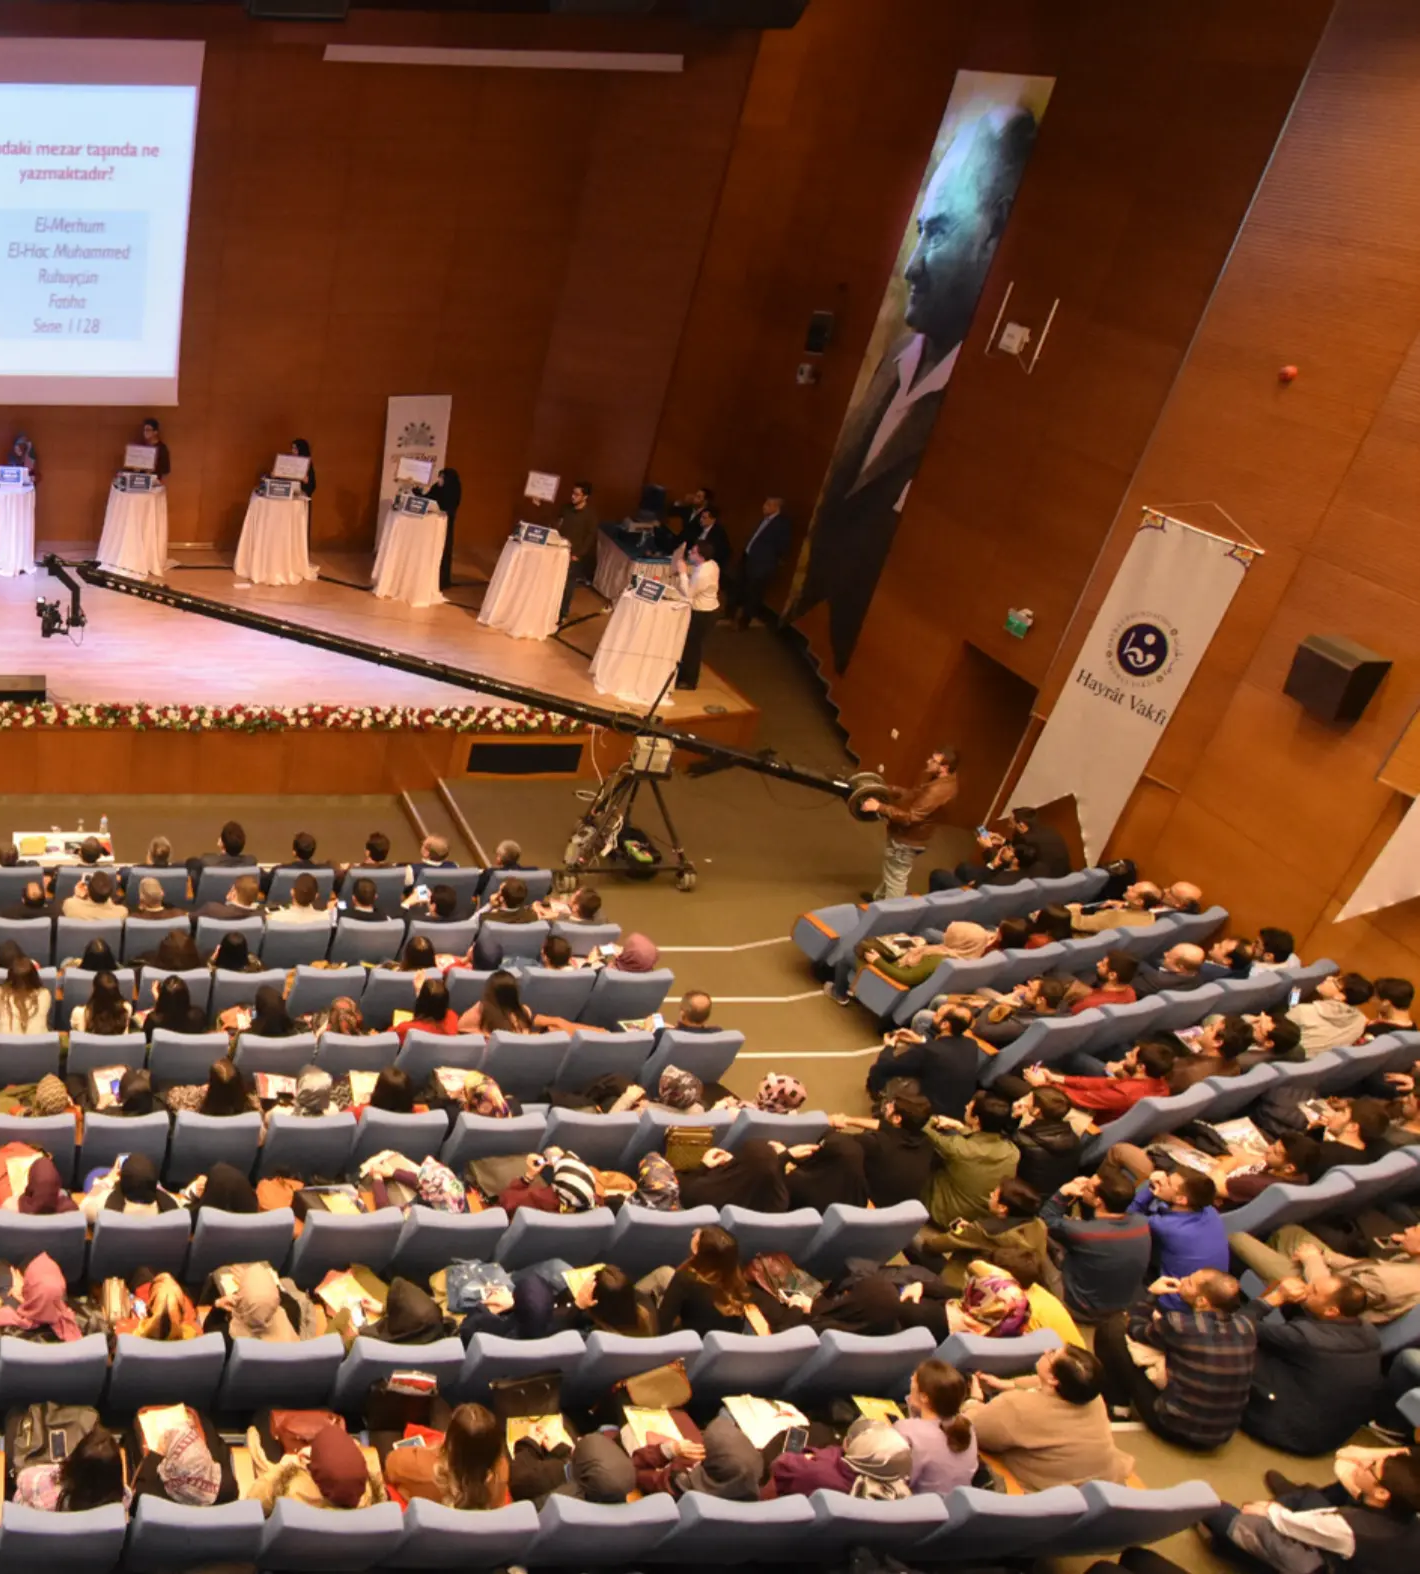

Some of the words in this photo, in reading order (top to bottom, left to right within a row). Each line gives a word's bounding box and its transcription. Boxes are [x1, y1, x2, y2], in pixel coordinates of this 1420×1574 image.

[36, 143, 82, 157] mezar
[87, 142, 138, 162] taşında
[142, 144, 160, 158] ne
[35, 216, 106, 234] El-Merhum
[54, 243, 131, 260] Muhammed
[33, 317, 63, 333] Sene
[68, 318, 101, 334] 1128
